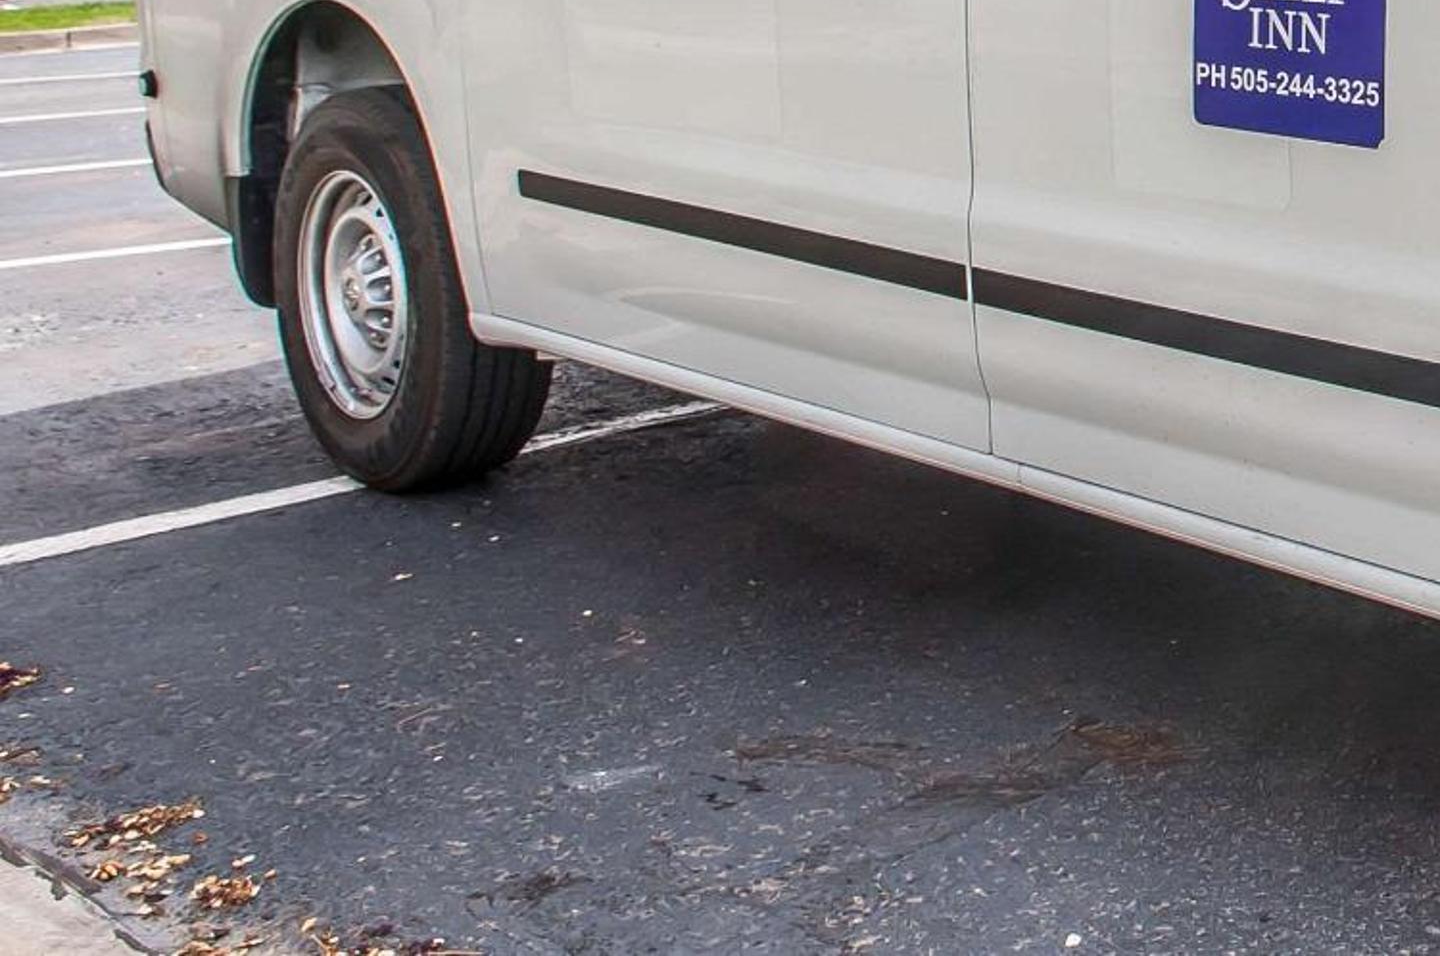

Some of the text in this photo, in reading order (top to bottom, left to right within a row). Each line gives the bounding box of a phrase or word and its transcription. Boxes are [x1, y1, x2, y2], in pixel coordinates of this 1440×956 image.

[1248, 7, 1331, 55] INN
[1196, 62, 1379, 107] PH 505-244-3325
